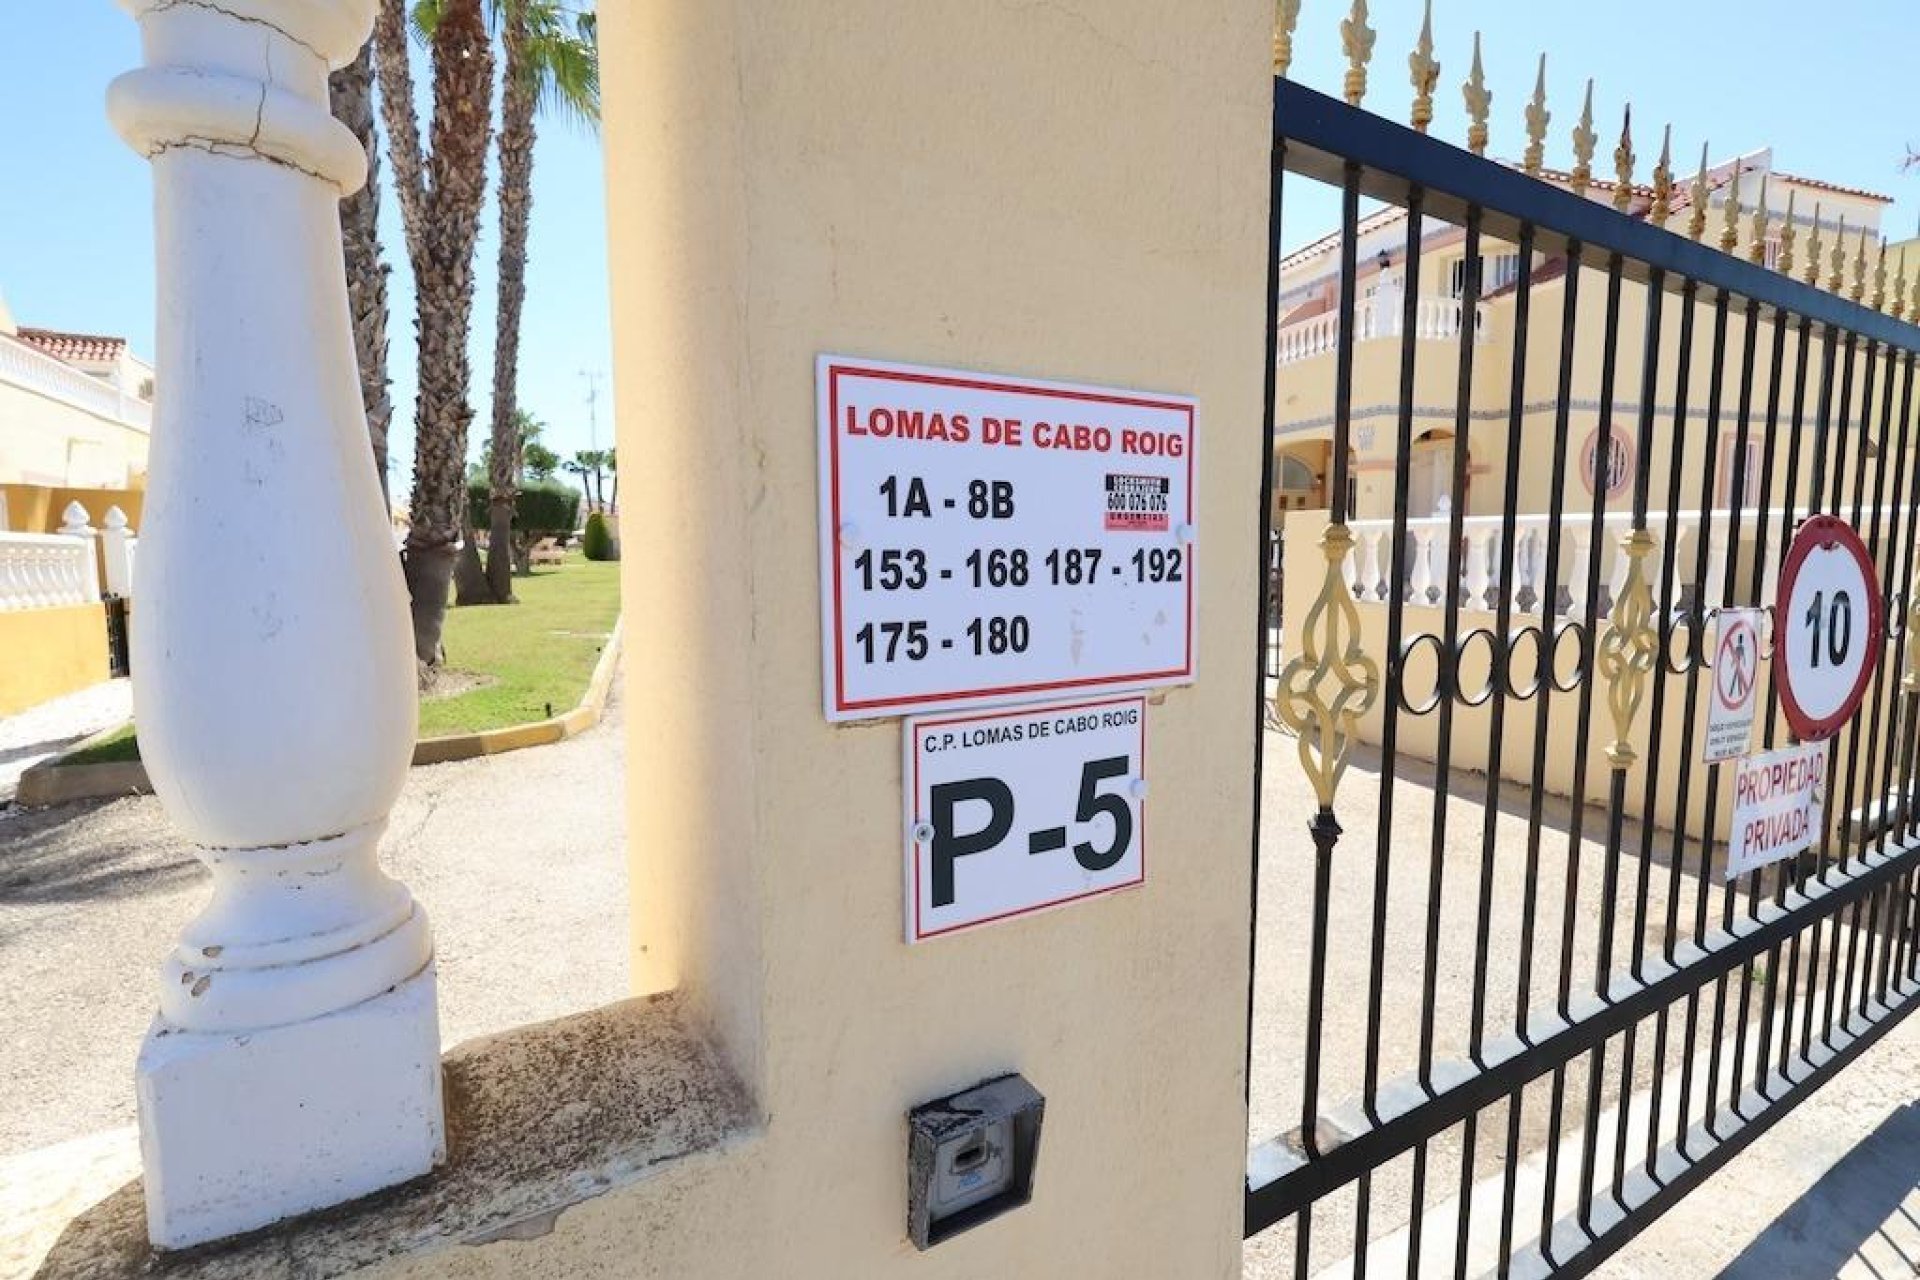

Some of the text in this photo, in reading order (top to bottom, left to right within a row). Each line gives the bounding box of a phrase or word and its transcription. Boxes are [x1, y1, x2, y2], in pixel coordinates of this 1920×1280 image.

[847, 406, 1183, 457] LOMAS DE CABO ROIG
[879, 475, 932, 518] 1A
[968, 479, 1014, 519] 8B
[854, 548, 928, 591] 153
[966, 548, 1030, 588] 168
[1045, 548, 1102, 586] 187
[1131, 547, 1183, 583] 192
[855, 620, 929, 665] 175
[966, 615, 1030, 656] 180
[1805, 590, 1852, 669] 10
[924, 709, 1138, 753] C.P. LOMAS DE CABO ROIG
[1736, 752, 1824, 809] PROPIEDAD
[930, 755, 1133, 909] P-5
[1742, 806, 1809, 859] PRIVADA
